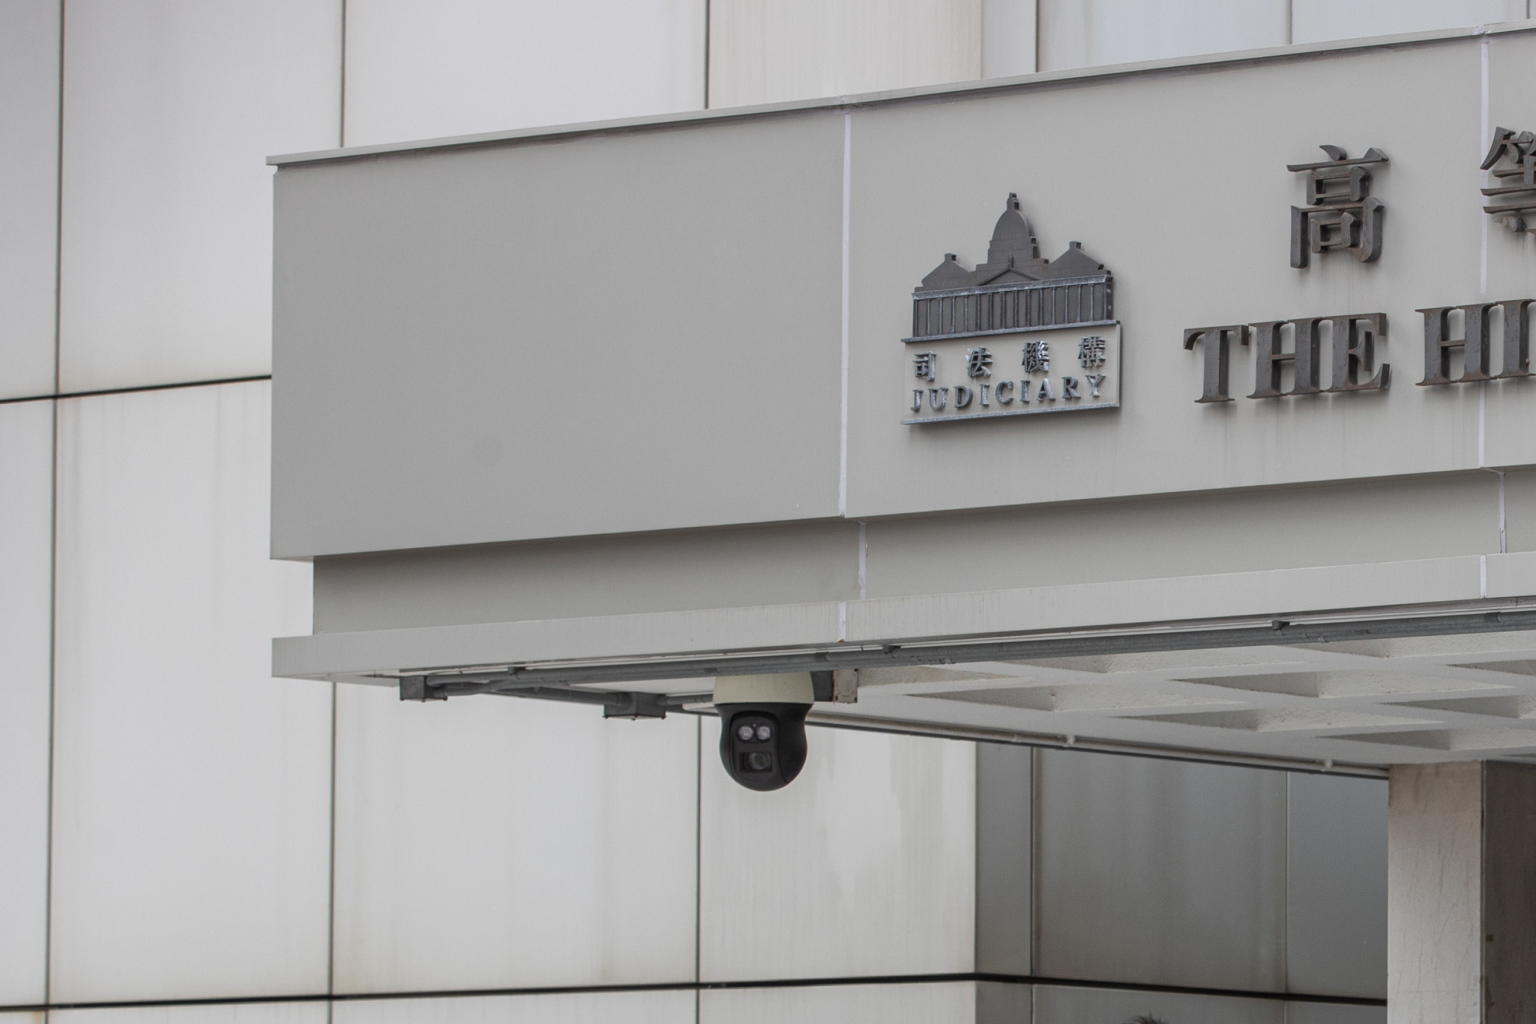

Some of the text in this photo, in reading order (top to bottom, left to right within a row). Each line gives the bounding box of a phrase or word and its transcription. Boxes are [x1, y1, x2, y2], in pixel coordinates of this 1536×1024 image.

[912, 335, 1107, 383] 司法機構
[1184, 311, 1391, 404] THE
[910, 372, 1107, 413] JUDICIARY
